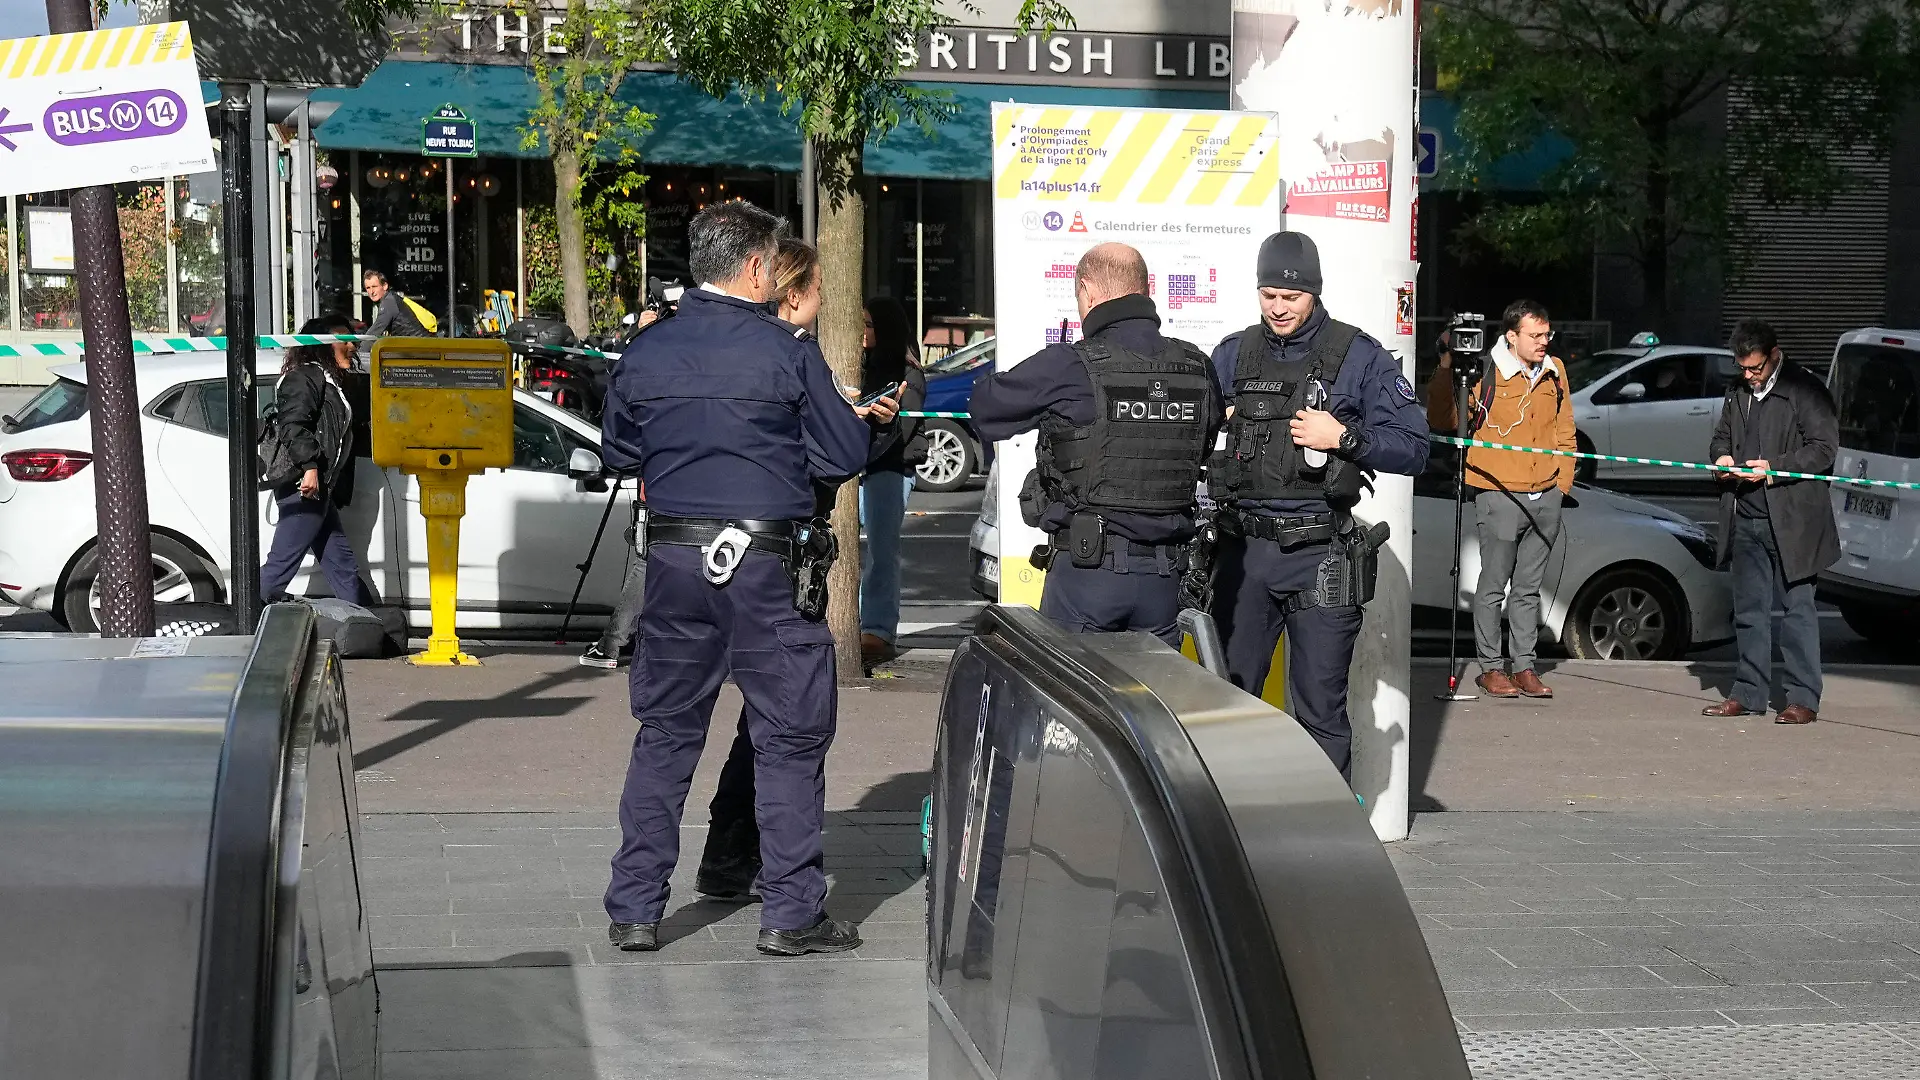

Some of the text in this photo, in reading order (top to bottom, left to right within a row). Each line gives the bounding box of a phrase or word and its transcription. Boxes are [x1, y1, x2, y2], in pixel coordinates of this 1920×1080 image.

[451, 12, 568, 55] THE
[116, 106, 136, 125] M
[147, 101, 174, 122] 14
[442, 126, 457, 136] RUE
[1020, 125, 1091, 137] Prolongement
[425, 137, 474, 149] NEUVE TOLBIAC
[1195, 135, 1231, 146] Grand
[1020, 146, 1028, 154] à
[1029, 145, 1075, 157] Aéroport
[1190, 145, 1219, 156] Paris
[1020, 155, 1087, 166] de la ligne 14
[1196, 157, 1242, 168] express
[1357, 163, 1379, 176] DES
[1020, 180, 1102, 193] la14plus14.fr
[1296, 176, 1384, 193] TRAVAILLEURS
[408, 213, 431, 221] LIVE
[1044, 214, 1062, 228] 14
[400, 225, 440, 233] SPORTS
[1094, 221, 1252, 235] Calendrier des fermetures
[412, 236, 427, 245] ON
[406, 247, 435, 261] HD
[397, 264, 444, 272] SCREENS
[1244, 381, 1283, 391] POLICE
[1116, 401, 1195, 420] POLICE
